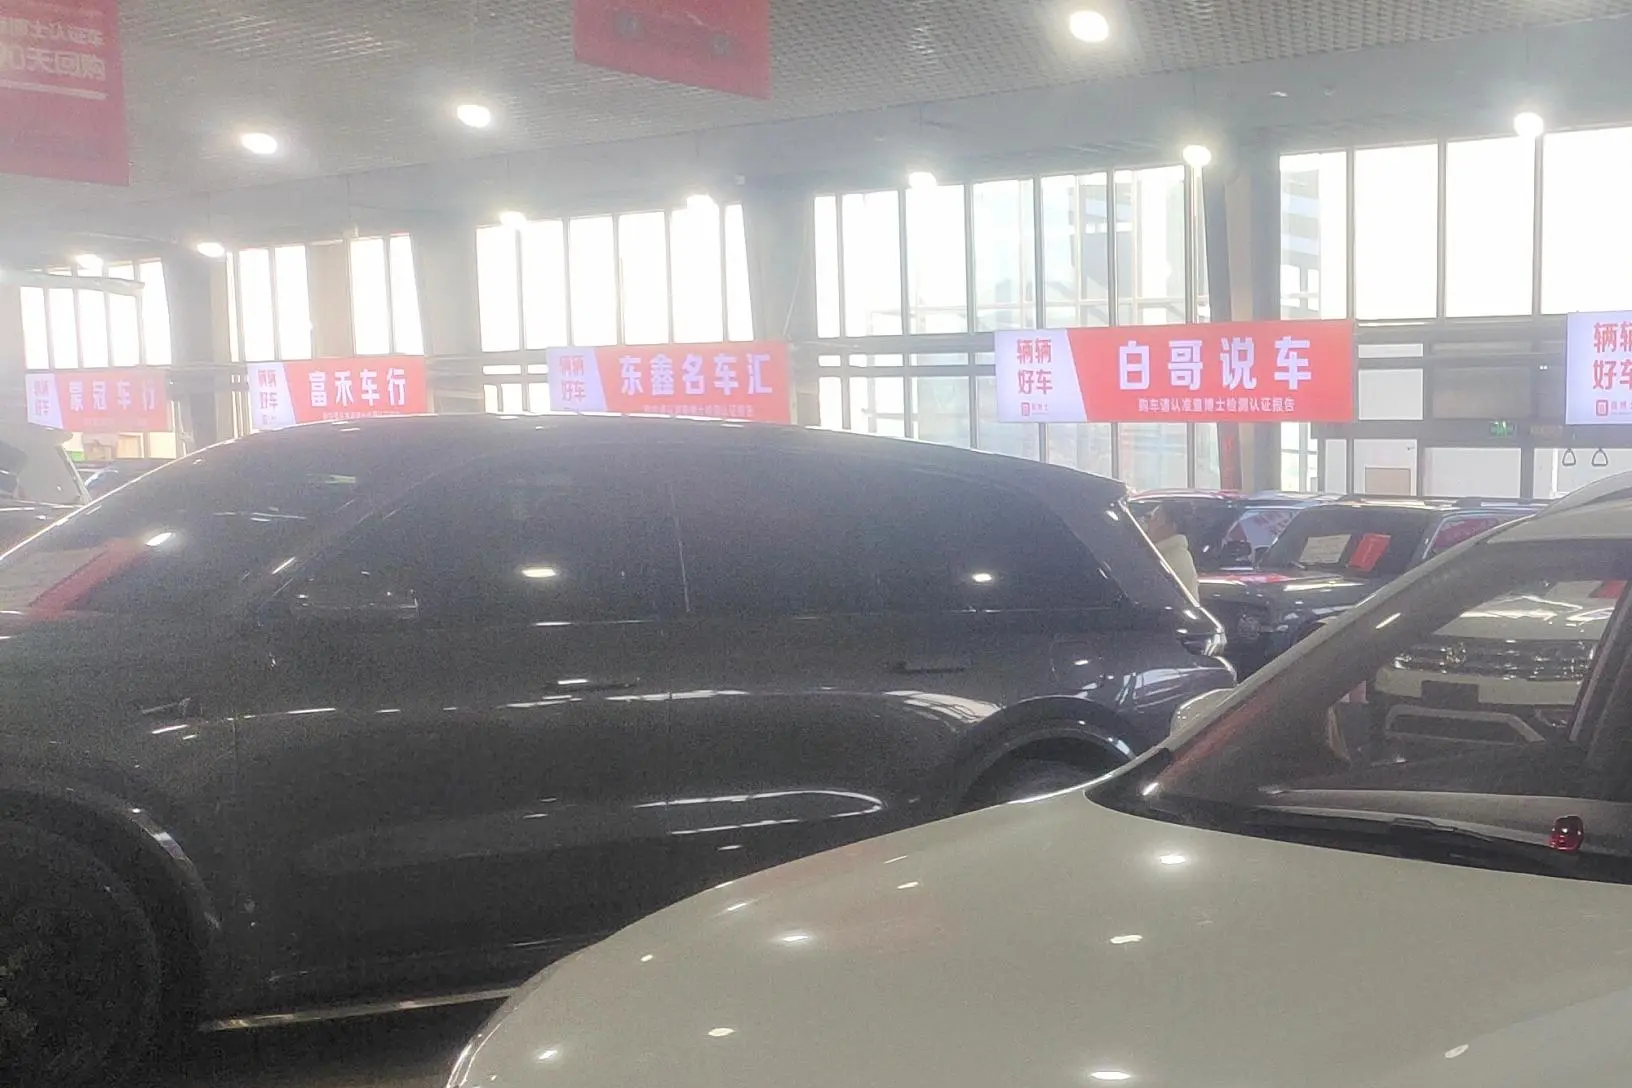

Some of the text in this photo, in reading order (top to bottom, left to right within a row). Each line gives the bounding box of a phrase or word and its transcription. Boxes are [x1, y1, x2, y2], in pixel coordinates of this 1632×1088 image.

[1017, 338, 1052, 364] 辆辆
[1118, 335, 1312, 390] 白哥说车
[309, 367, 406, 407] 富禾车行
[619, 353, 773, 396] 东鑫名车汇
[1017, 369, 1053, 395] 好车
